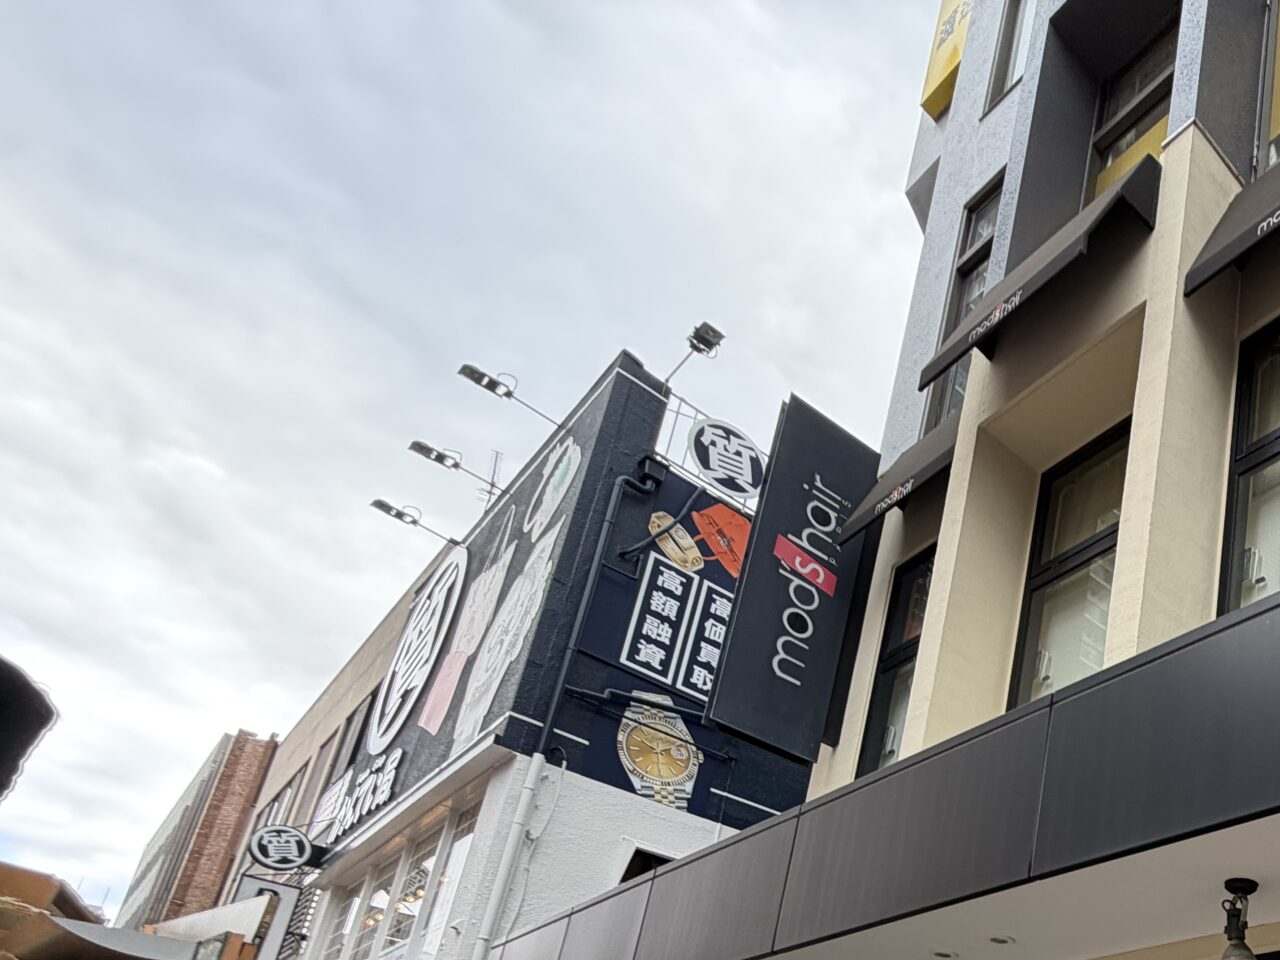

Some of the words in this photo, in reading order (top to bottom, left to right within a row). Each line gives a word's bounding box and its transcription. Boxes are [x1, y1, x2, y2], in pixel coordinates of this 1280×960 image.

[701, 424, 760, 495] 質
[787, 472, 842, 561] hair
[634, 565, 687, 672] 高額融資
[772, 556, 825, 686] mod's
[261, 832, 300, 865] 質
